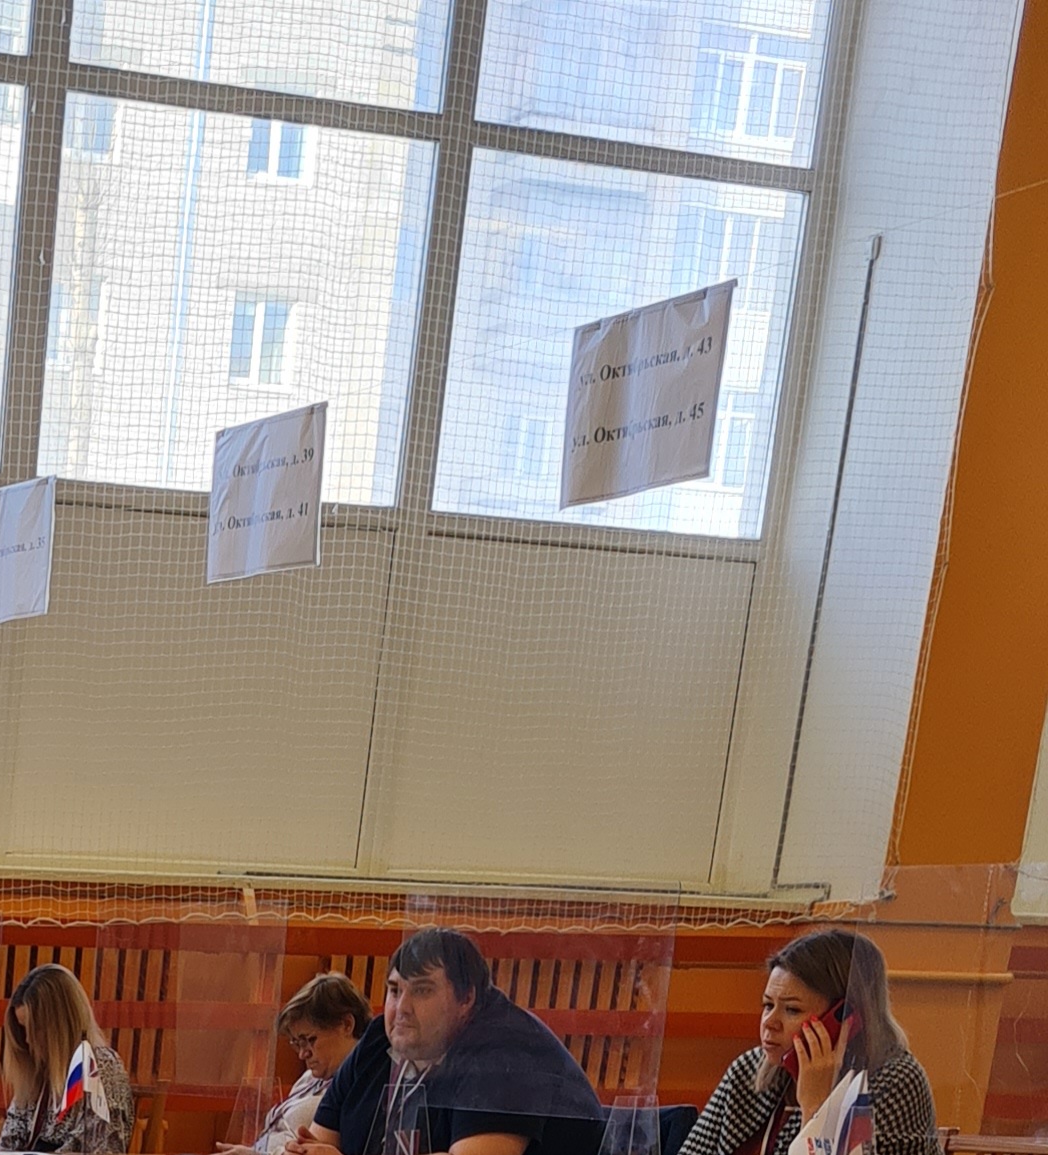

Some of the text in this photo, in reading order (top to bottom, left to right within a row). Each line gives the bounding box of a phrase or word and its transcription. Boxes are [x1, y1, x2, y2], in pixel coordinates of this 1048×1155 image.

[697, 336, 713, 356] 43
[690, 402, 705, 420] 45
[233, 455, 289, 478] Октябская,
[302, 447, 315, 462] 39
[227, 508, 284, 530] Октяская,
[297, 502, 309, 517] 41
